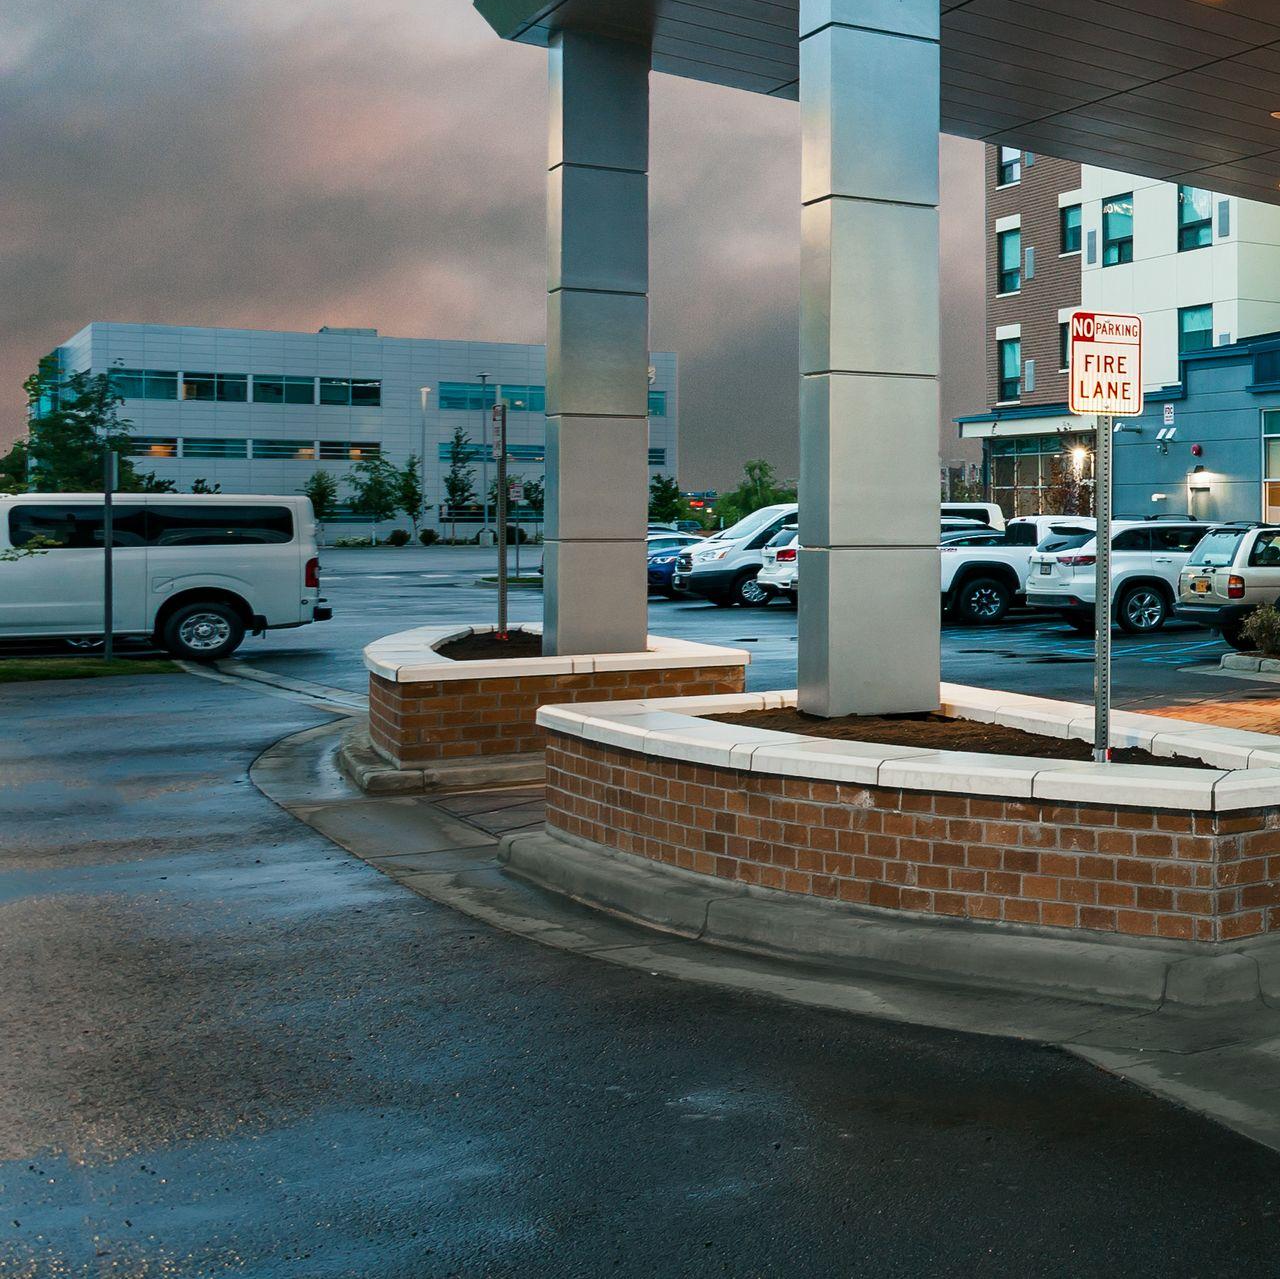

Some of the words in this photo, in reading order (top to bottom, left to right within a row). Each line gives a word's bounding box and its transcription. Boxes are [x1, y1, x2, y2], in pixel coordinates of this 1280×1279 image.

[1073, 317, 1094, 338] NO
[1096, 322, 1138, 338] PARKING
[1084, 354, 1127, 374] FIRE
[1080, 380, 1131, 400] LANE
